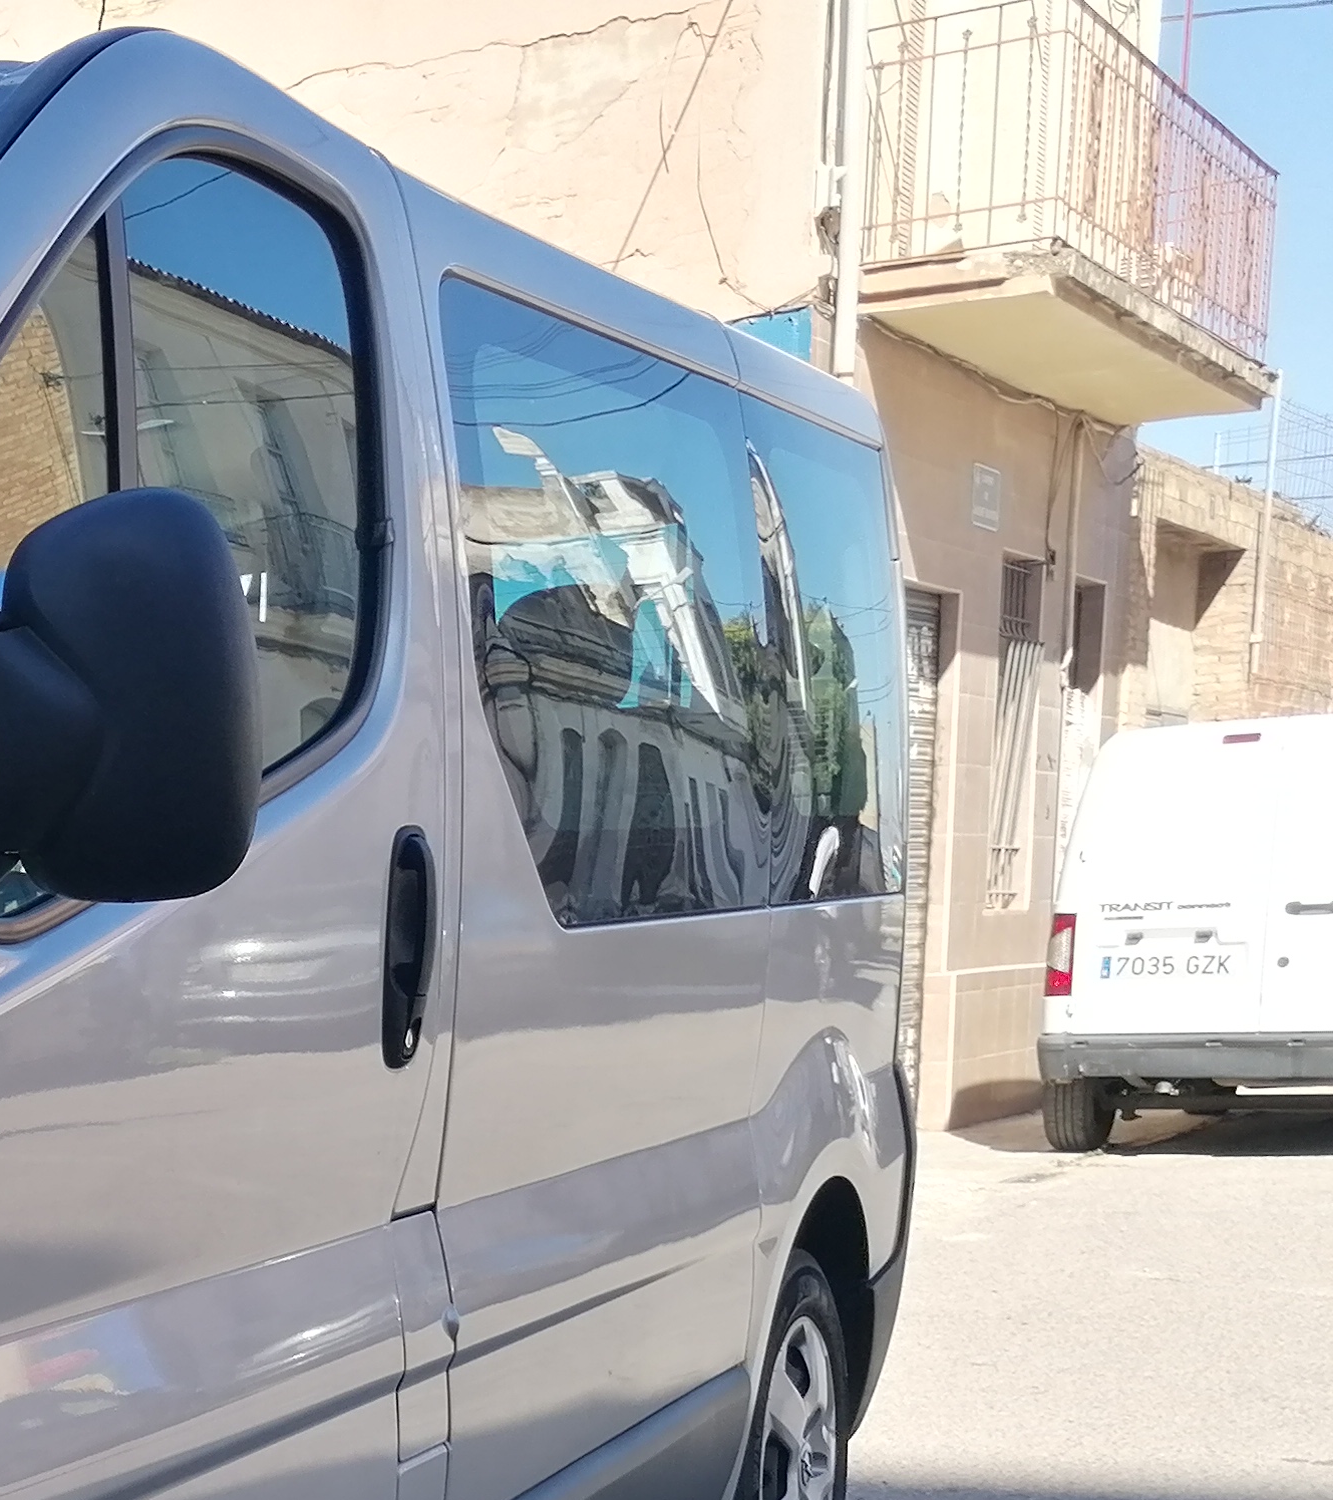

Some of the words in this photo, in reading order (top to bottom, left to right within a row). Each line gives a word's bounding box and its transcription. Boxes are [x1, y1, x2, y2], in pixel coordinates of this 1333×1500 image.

[1099, 901, 1174, 912] TRANSIT
[1116, 956, 1175, 976] 7035
[1186, 955, 1231, 975] GZK
